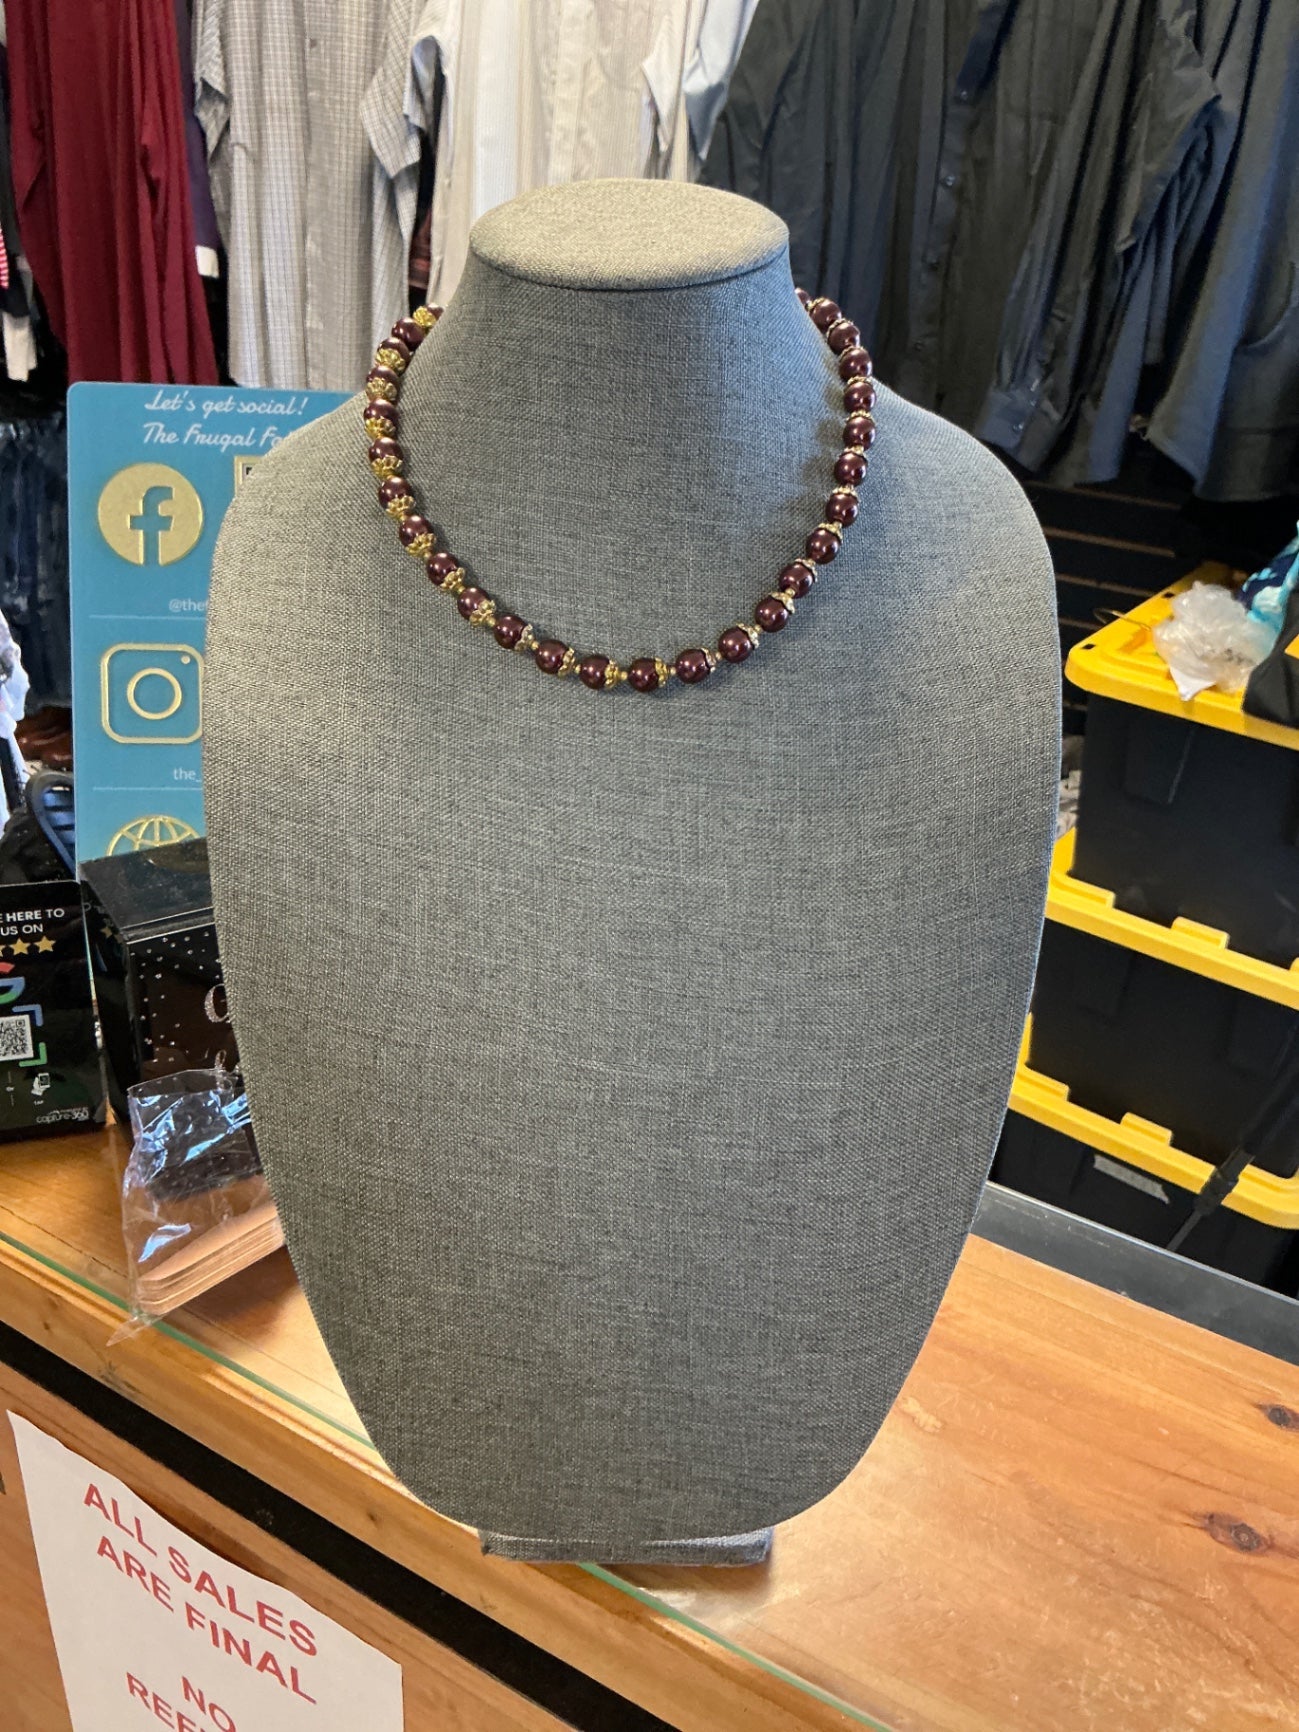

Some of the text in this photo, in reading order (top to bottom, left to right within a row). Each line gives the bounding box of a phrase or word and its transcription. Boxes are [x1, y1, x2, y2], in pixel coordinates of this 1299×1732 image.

[144, 389, 309, 419] Let's get social!
[143, 422, 180, 444] The
[183, 423, 257, 453] Frugal
[0, 923, 43, 936] US ON
[6, 910, 42, 922] HERE
[45, 908, 65, 918] TO
[83, 1483, 317, 1656] ALL SALES
[96, 1535, 317, 1705] ARE FINAL
[126, 1671, 206, 1732] REF
[181, 1675, 236, 1732] NO
